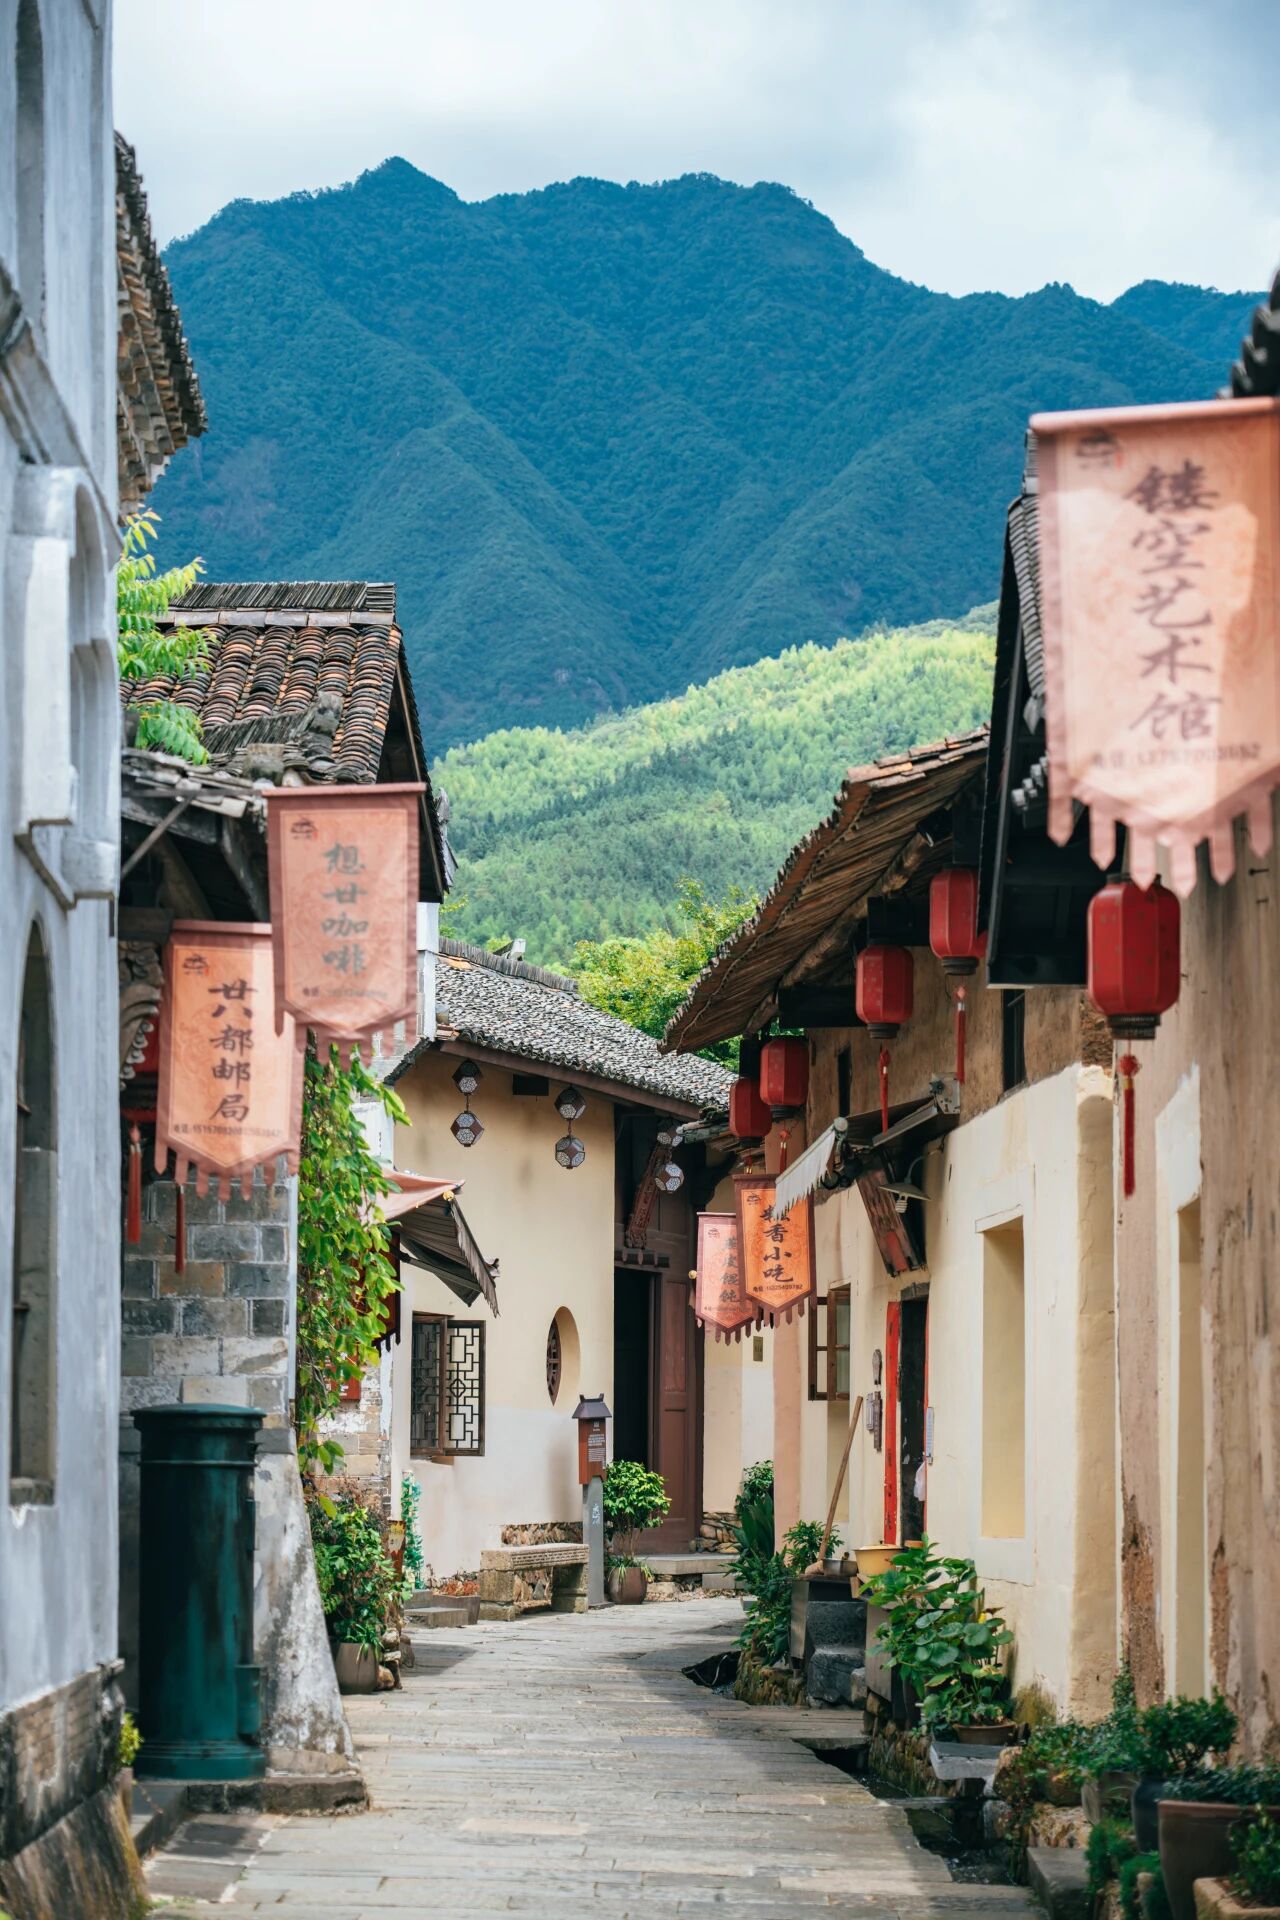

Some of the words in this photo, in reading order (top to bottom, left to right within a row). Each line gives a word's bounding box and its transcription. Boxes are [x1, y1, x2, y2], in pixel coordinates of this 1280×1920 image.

[1122, 458, 1223, 741] 镂空艺术馆
